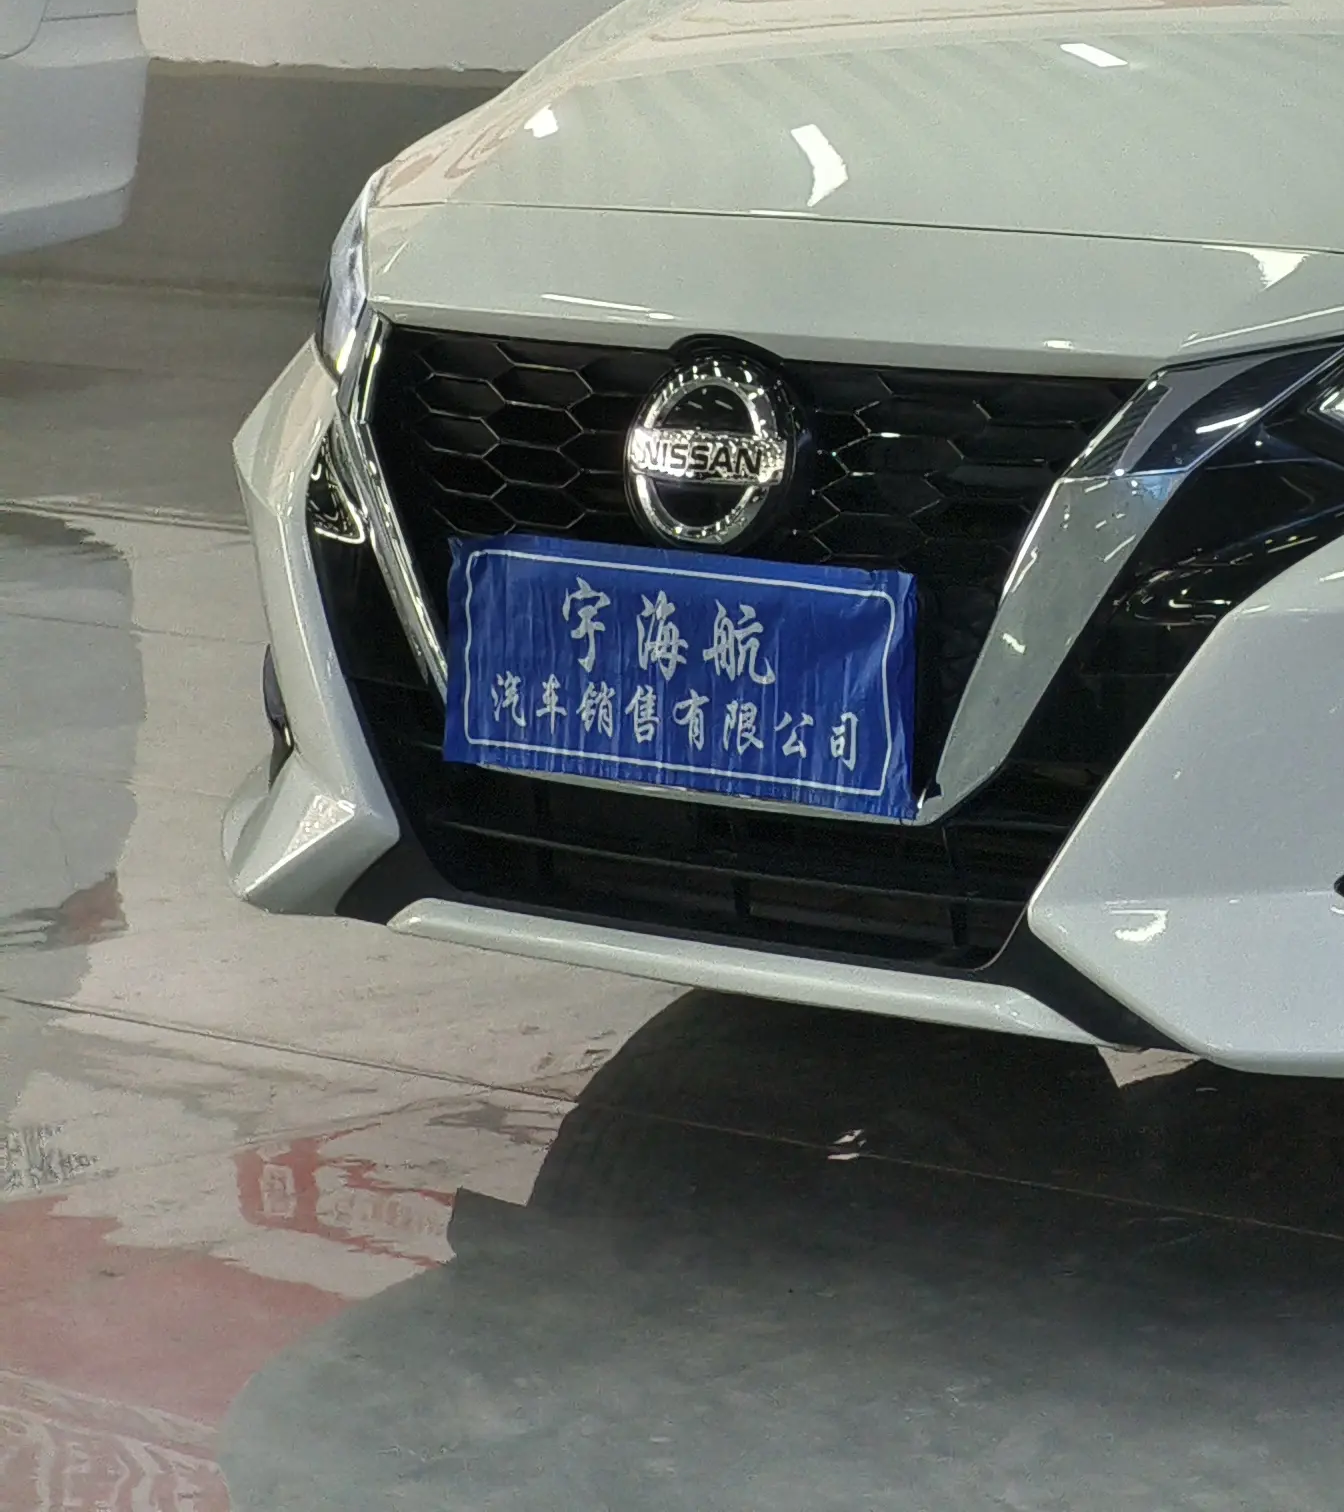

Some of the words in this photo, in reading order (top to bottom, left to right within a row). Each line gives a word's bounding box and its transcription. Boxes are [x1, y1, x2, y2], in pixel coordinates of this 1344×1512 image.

[637, 439, 763, 475] NISSAN
[562, 576, 776, 685] 宇海航
[491, 672, 859, 771] 汽车销售有限公司
